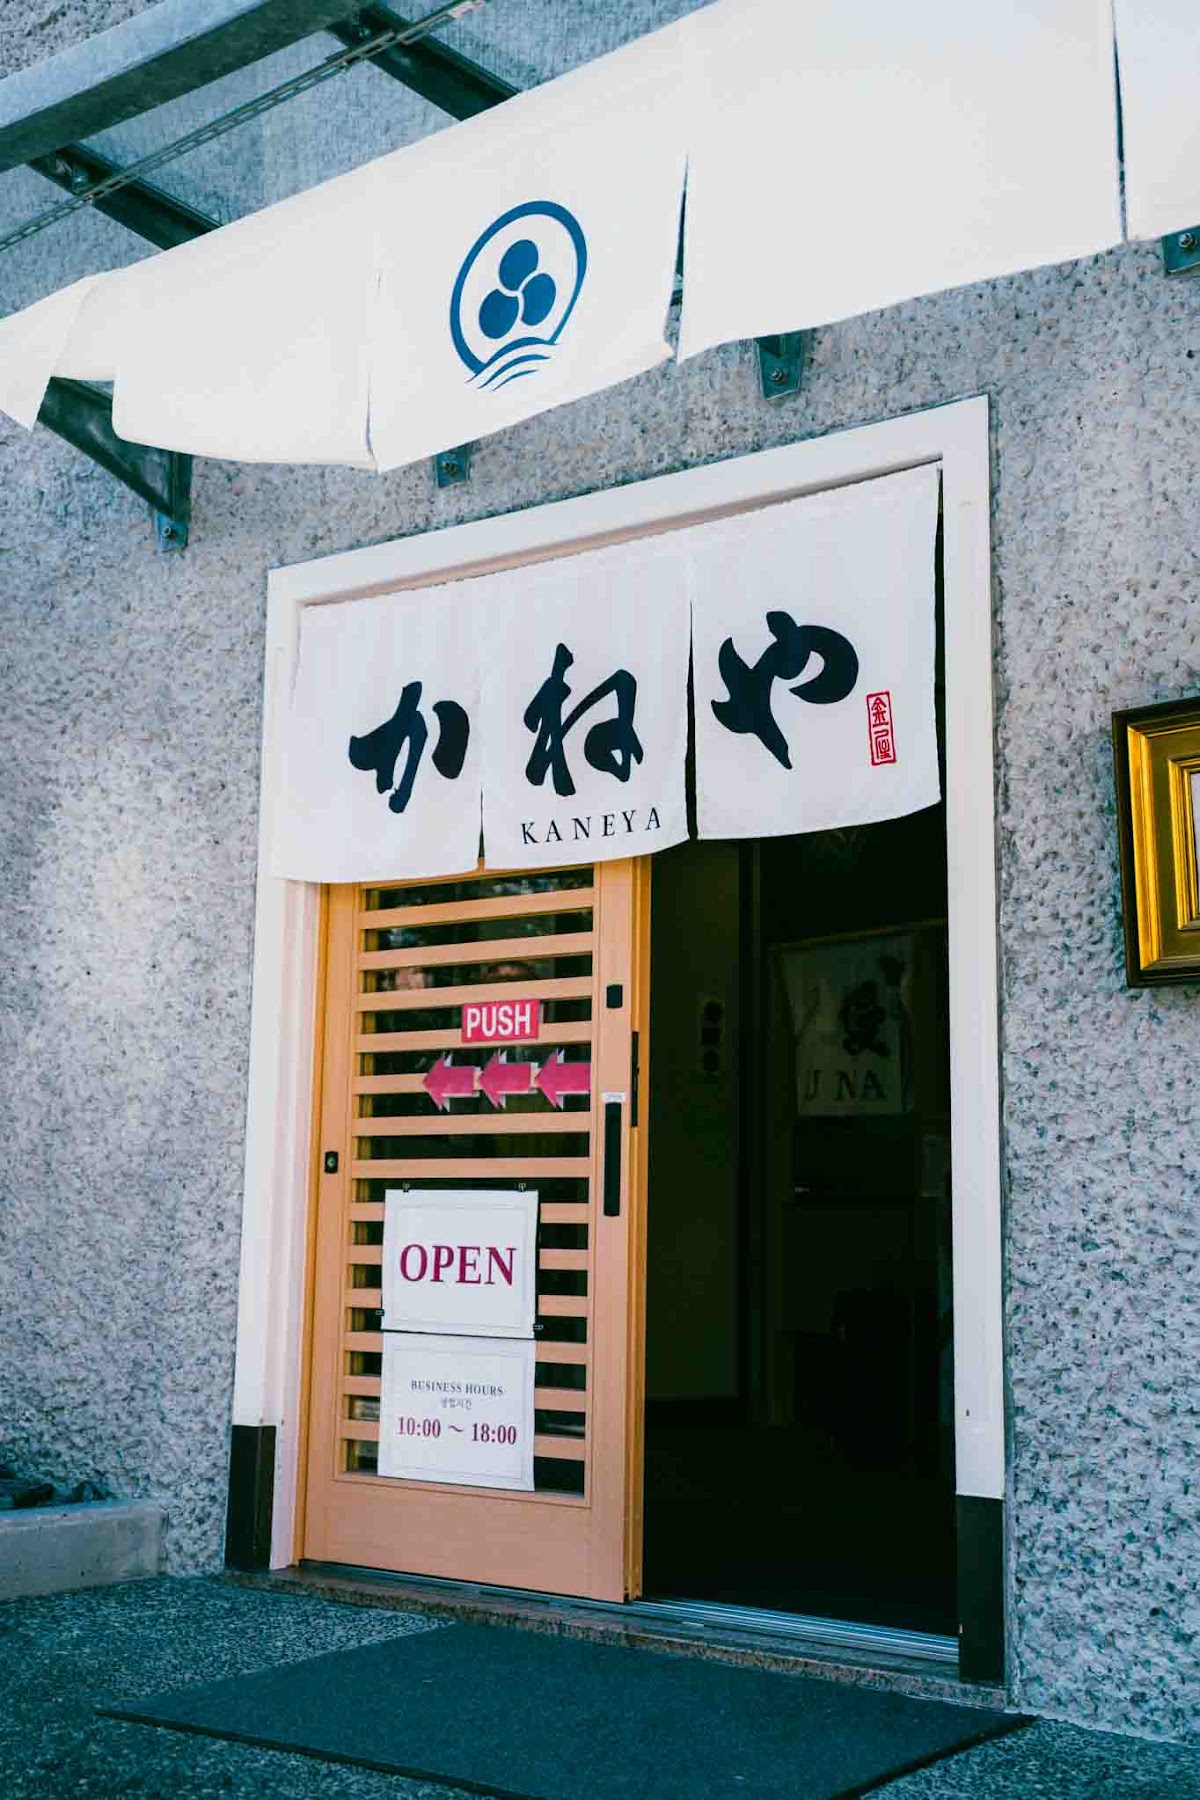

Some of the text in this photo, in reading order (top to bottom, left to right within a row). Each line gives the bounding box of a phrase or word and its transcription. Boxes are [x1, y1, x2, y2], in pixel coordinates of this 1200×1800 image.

[349, 611, 859, 814] かねや
[520, 807, 662, 846] KANEYA
[466, 1003, 532, 1038] PUSH
[400, 1244, 517, 1286] OPEN
[410, 1379, 504, 1397] BUSINESS HOURS
[396, 1415, 441, 1439] 10:00
[472, 1422, 517, 1445] 18:00
